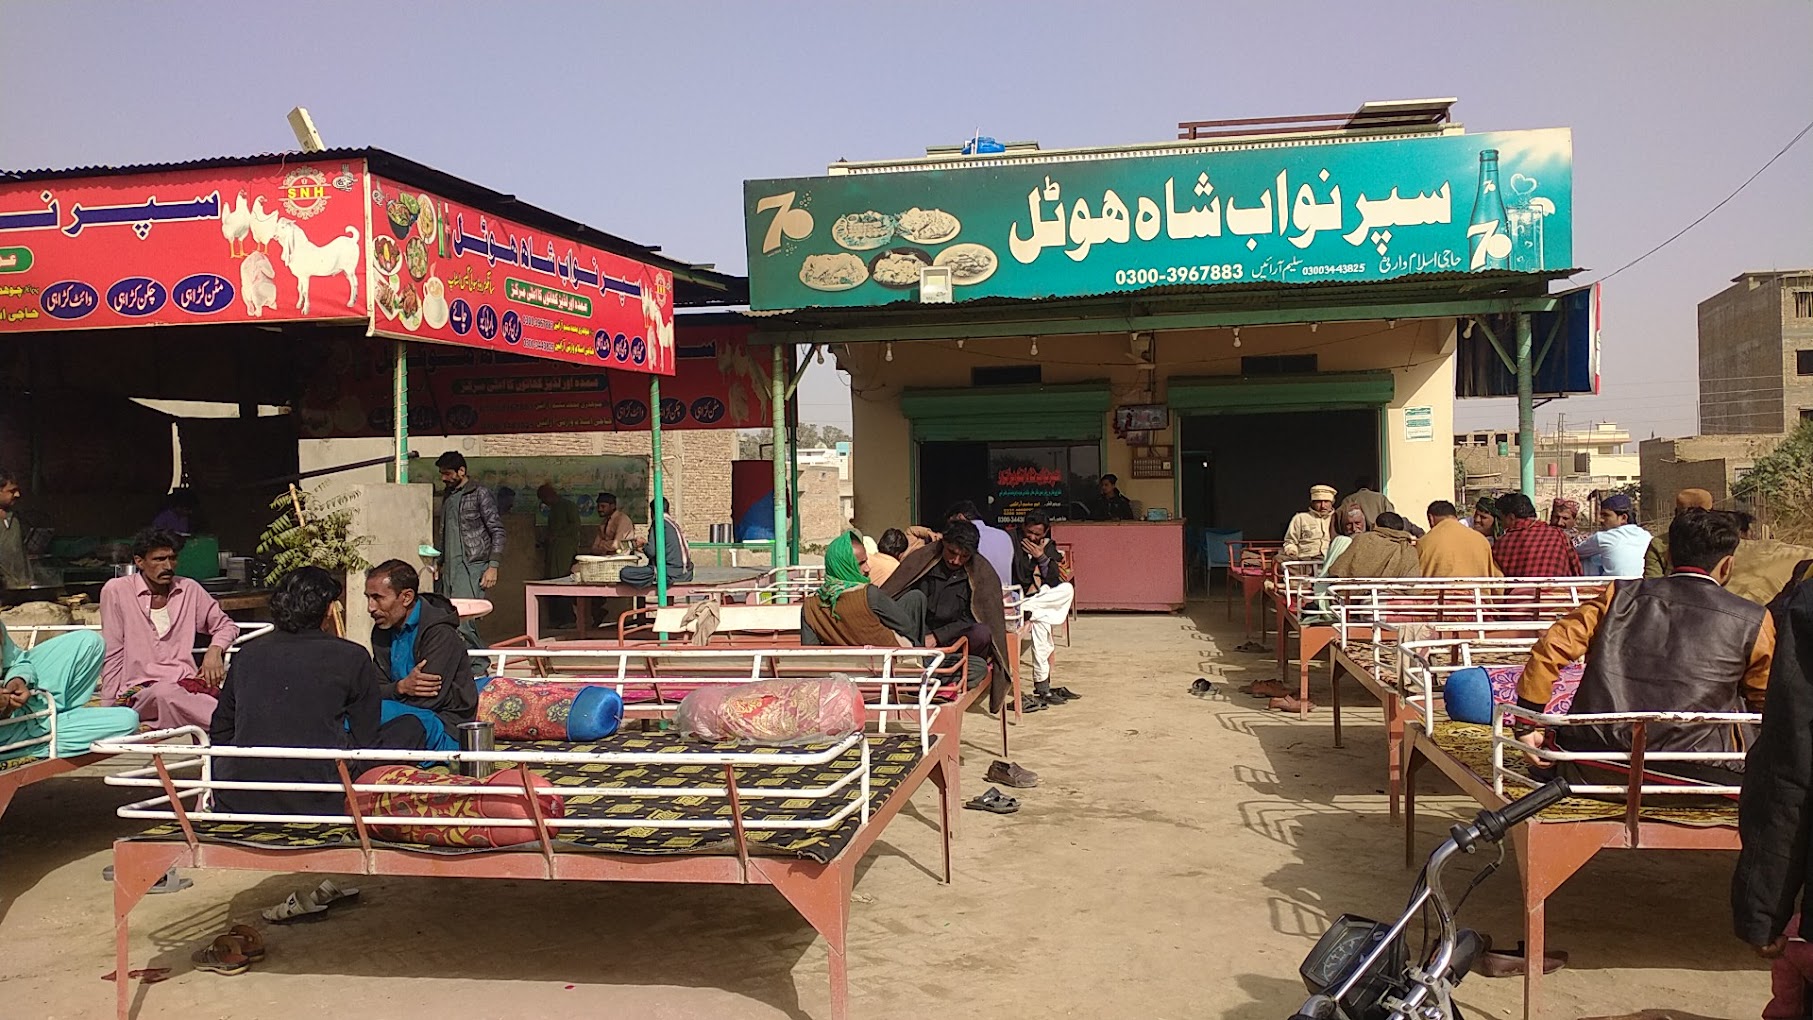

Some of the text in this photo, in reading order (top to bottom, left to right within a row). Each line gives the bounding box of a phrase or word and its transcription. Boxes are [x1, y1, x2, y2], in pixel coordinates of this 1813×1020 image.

[287, 186, 324, 198] SNH
[61, 190, 220, 240] سپر
[1135, 171, 1221, 241] شاہ
[1226, 168, 1342, 251] نواب
[1342, 180, 1451, 256] سپر
[1281, 256, 1304, 280] سلیم
[1409, 251, 1438, 272] اسلام
[1438, 249, 1462, 268] حاجی
[1115, 263, 1244, 285] 0300-3967883
